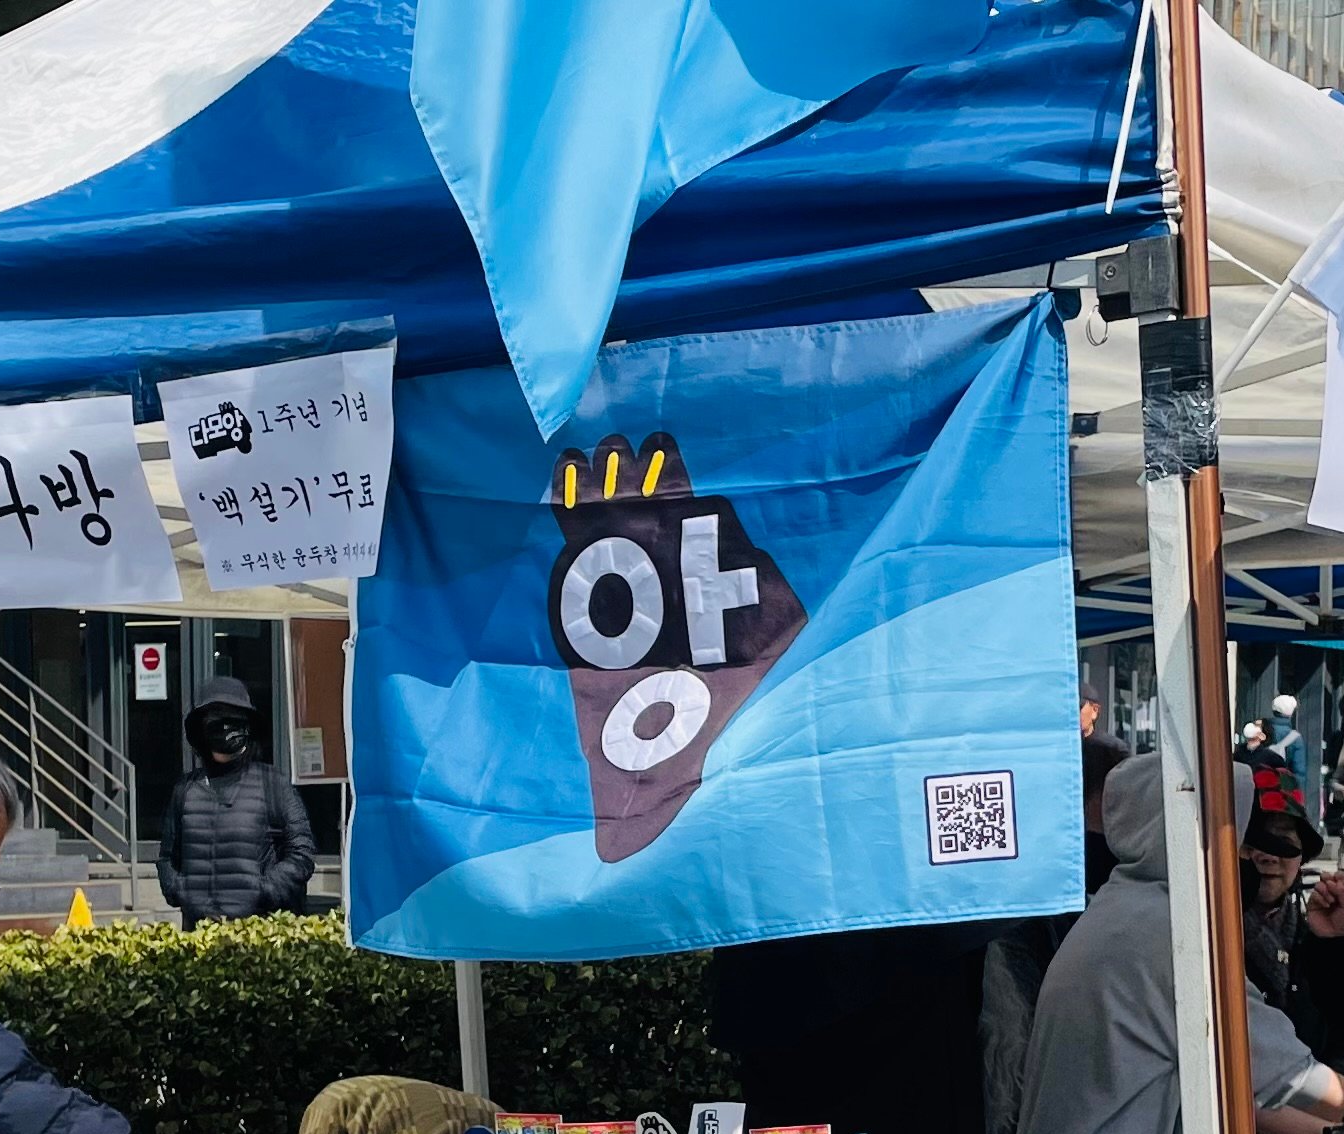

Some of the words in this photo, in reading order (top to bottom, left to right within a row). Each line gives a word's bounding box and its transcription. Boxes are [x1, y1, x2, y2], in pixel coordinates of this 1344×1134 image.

[189, 407, 246, 446] 다모앙
[257, 399, 321, 433] 1주년
[332, 392, 368, 422] 기념
[328, 471, 374, 513] 무료
[241, 550, 286, 573] 무식한
[293, 544, 338, 568] 윤두창
[560, 513, 759, 772] 앙
